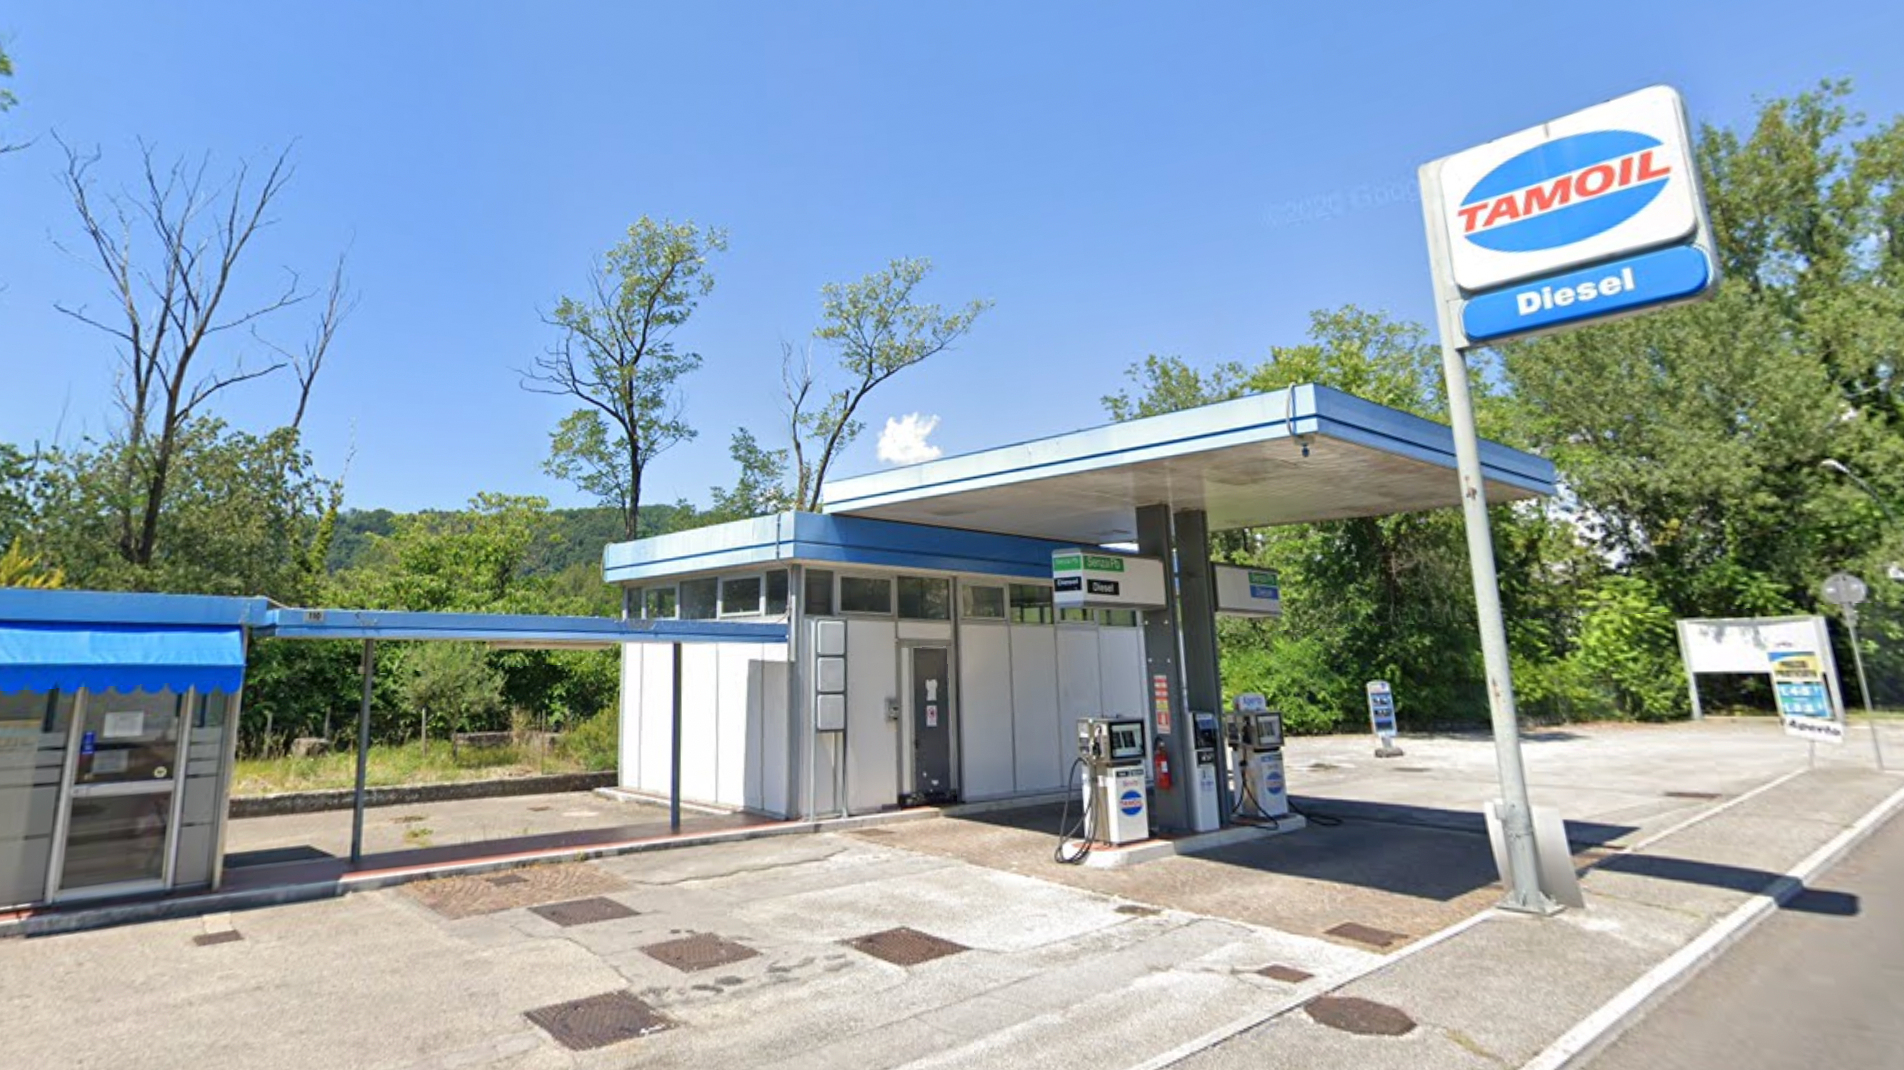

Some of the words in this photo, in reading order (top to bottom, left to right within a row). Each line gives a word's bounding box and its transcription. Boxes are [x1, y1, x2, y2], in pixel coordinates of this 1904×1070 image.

[1457, 150, 1671, 232] TAMOIL
[1516, 267, 1636, 316] Diesel
[1092, 581, 1114, 593] Diesel
